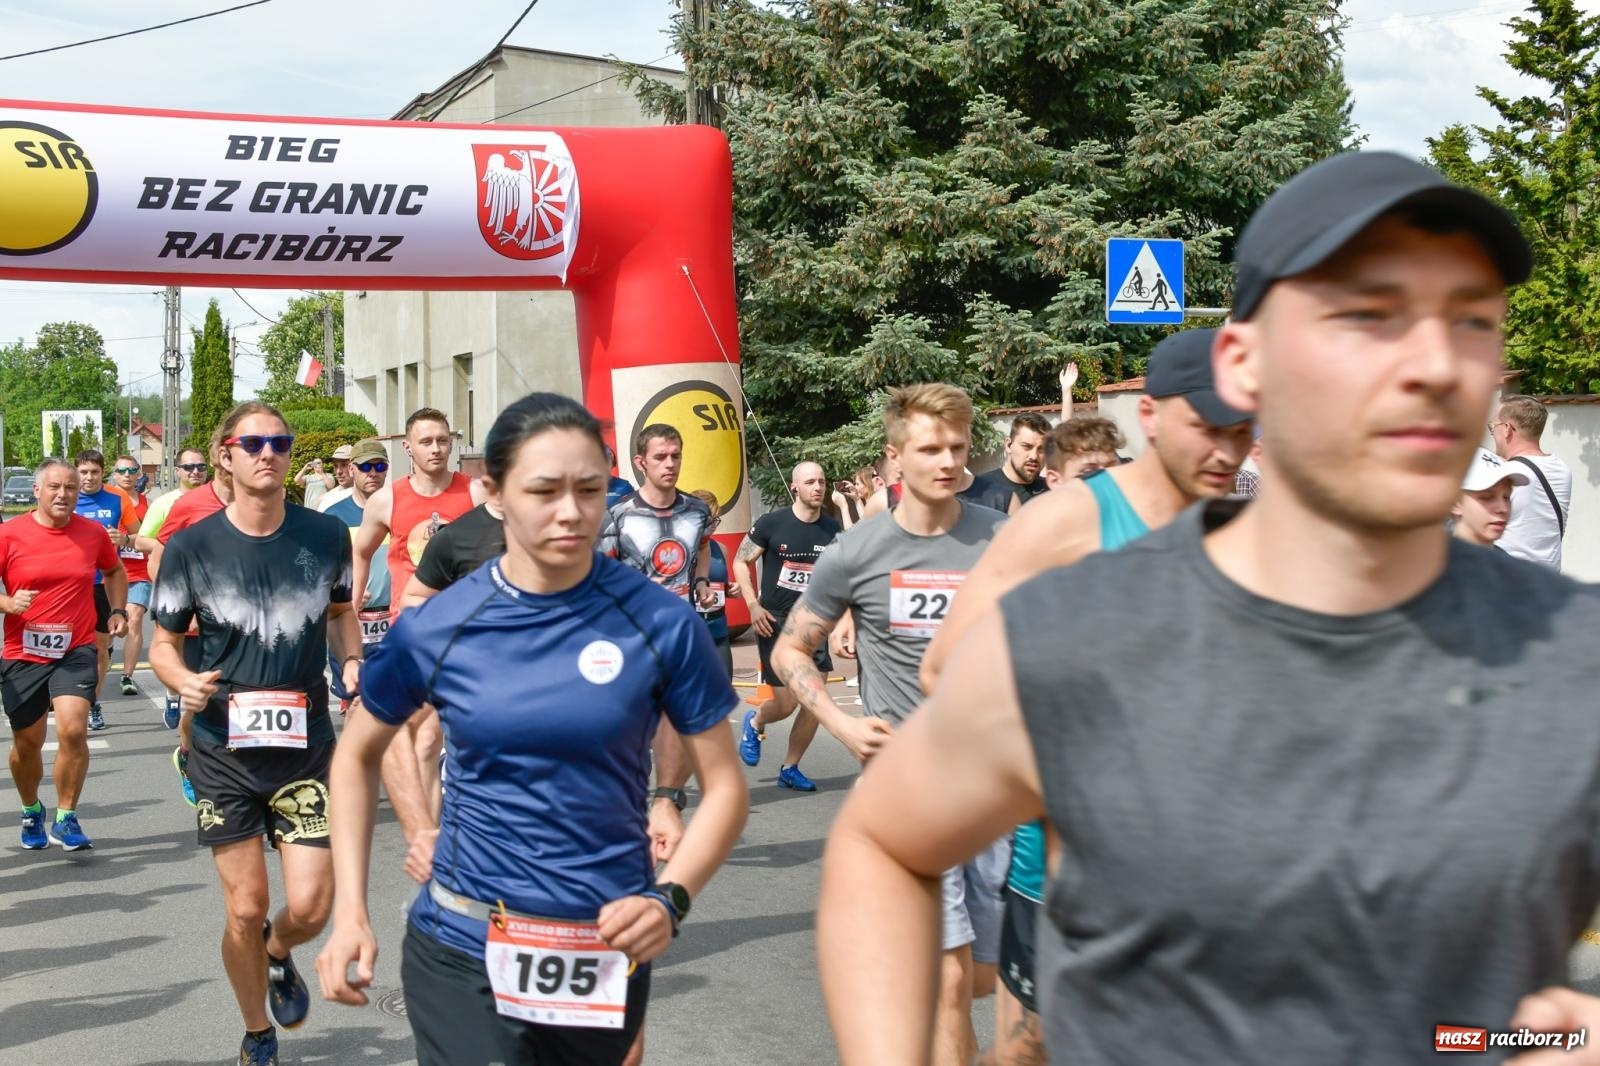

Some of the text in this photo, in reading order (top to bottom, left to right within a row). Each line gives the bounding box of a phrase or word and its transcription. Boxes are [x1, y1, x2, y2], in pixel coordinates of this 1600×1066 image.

[14, 140, 94, 171] SIR
[225, 135, 341, 163] BIEG
[137, 177, 429, 216] BEZ GRANIC
[158, 226, 404, 262] RACIBÓRZ
[692, 403, 741, 431] SIR
[909, 593, 948, 619] 22
[32, 633, 64, 649] 142
[362, 620, 389, 636] 140
[246, 709, 293, 731] 210
[516, 952, 599, 997] 195
